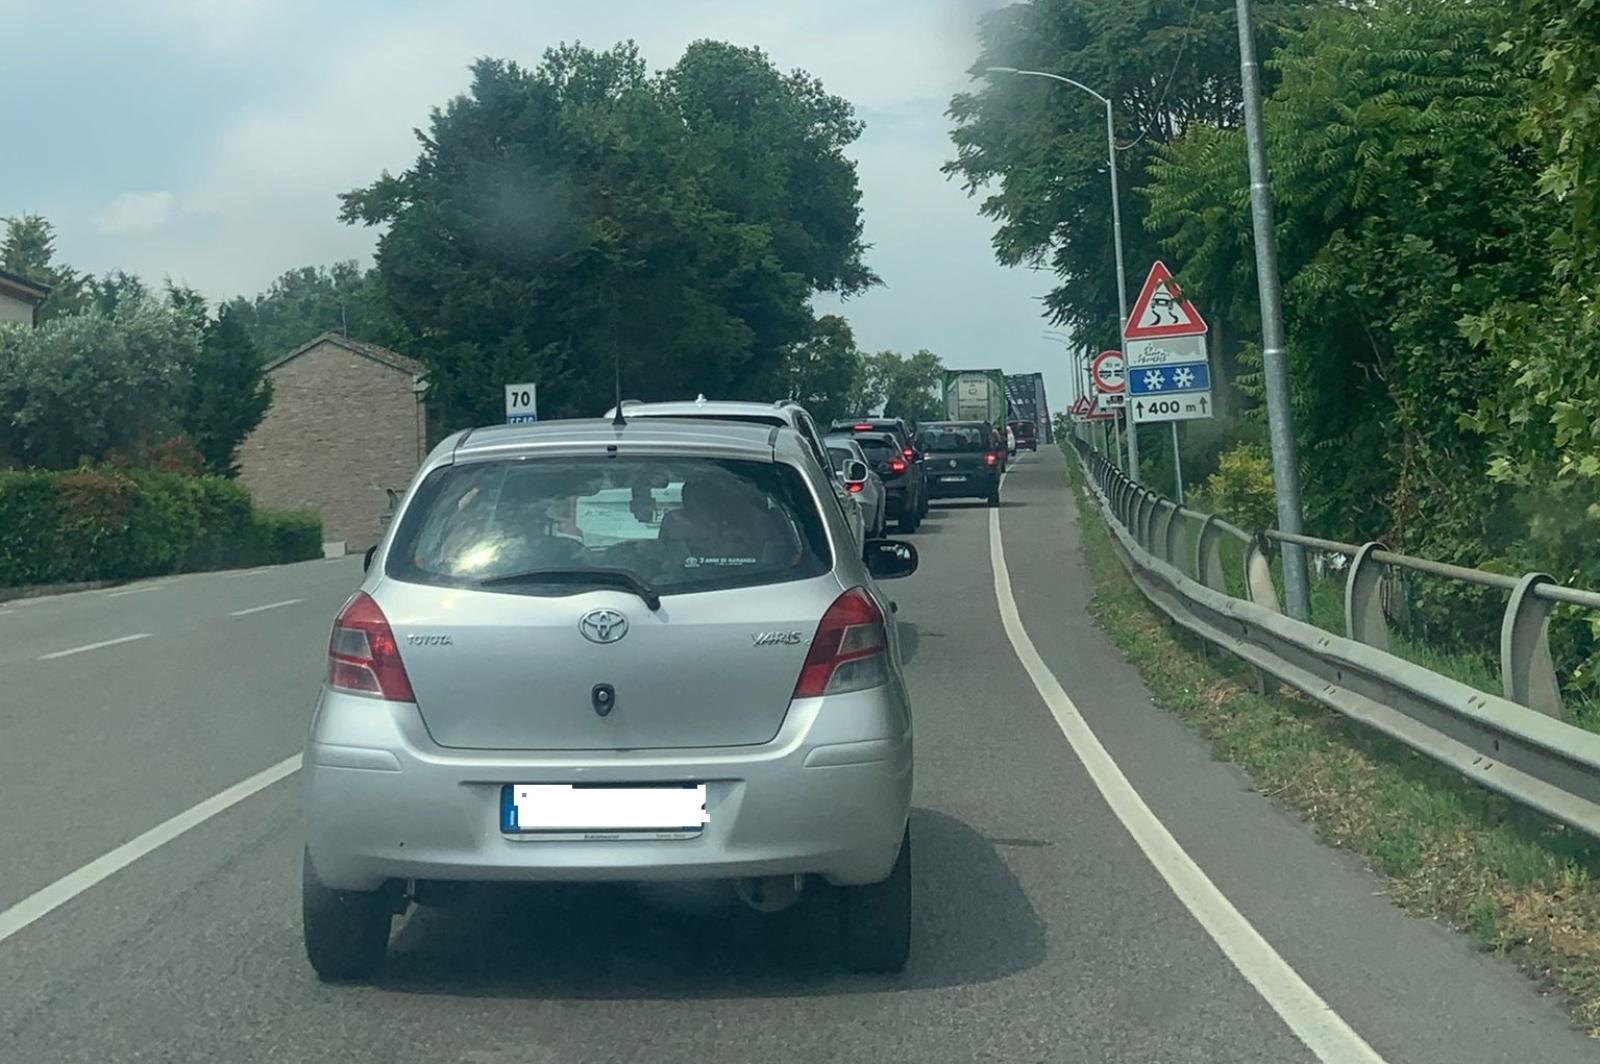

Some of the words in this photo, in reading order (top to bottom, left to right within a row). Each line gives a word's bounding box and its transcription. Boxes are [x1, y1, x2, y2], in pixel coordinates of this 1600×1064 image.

[511, 391, 531, 408] 70
[1148, 400, 1181, 415] 400
[1185, 403, 1197, 412] m
[407, 633, 454, 646] TOYOTA
[751, 631, 803, 647] YARIS
